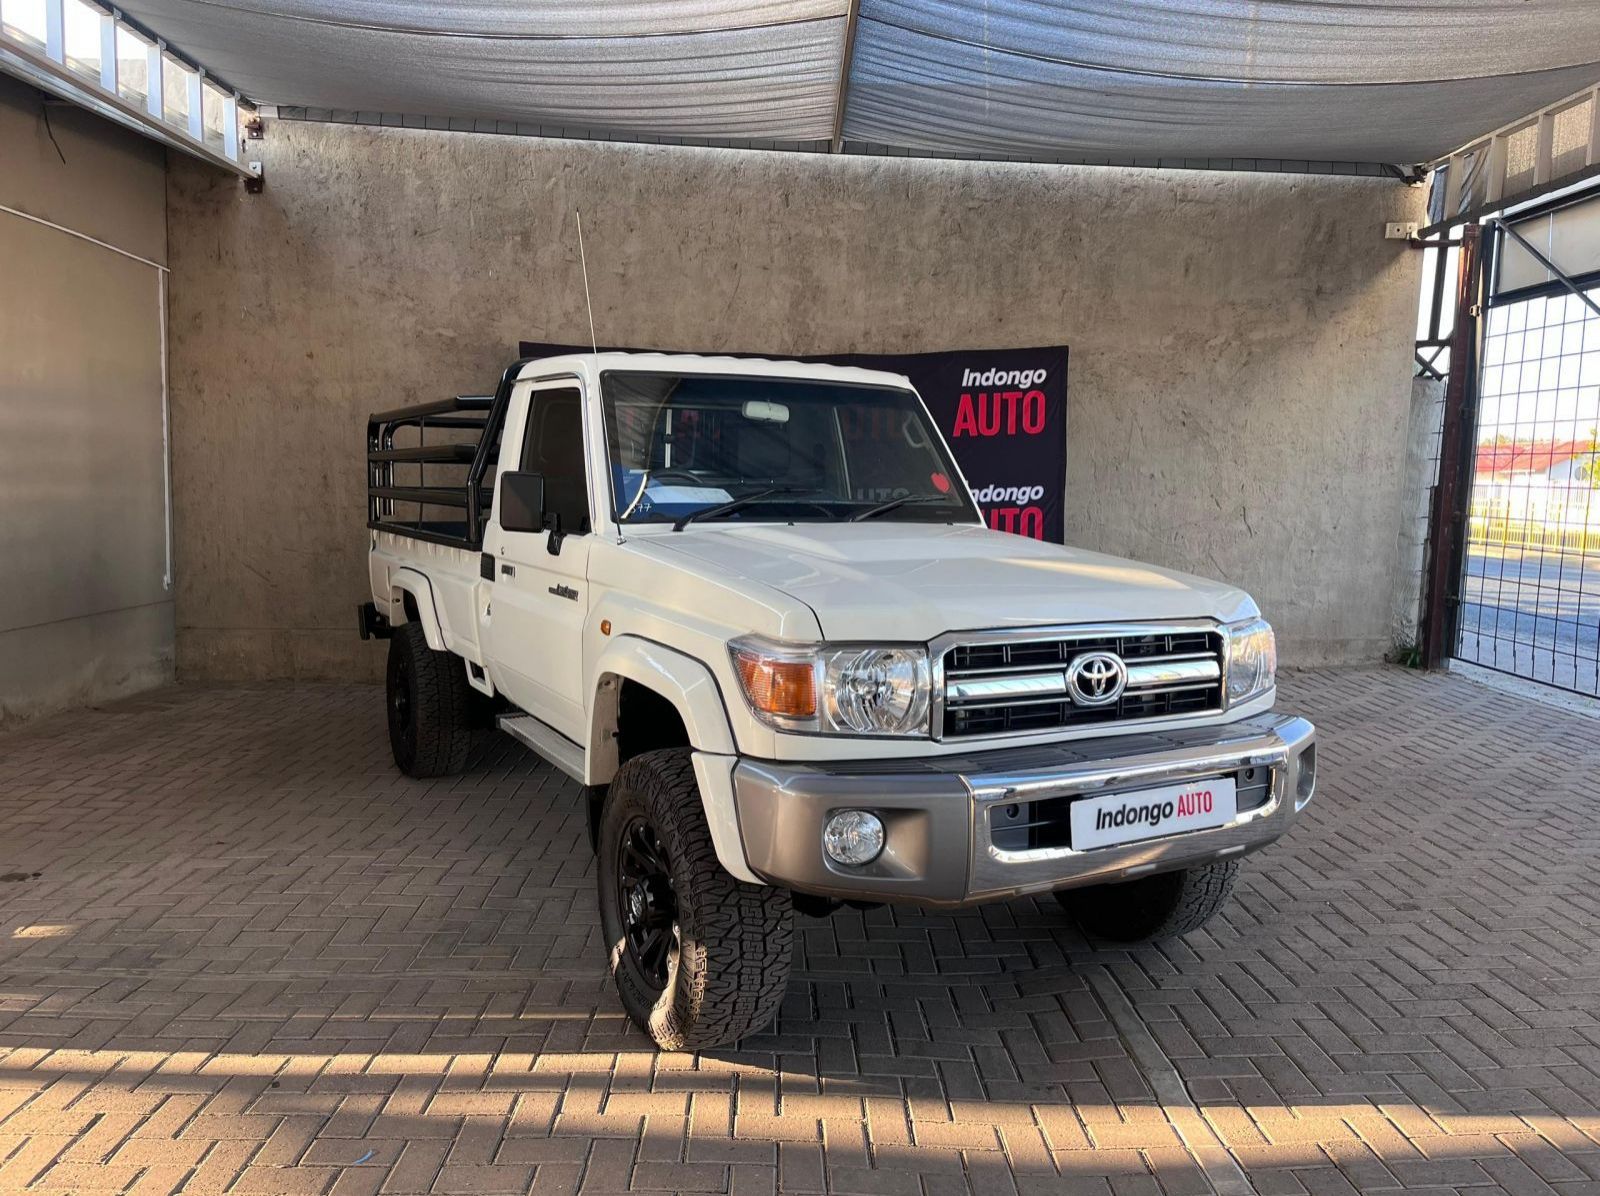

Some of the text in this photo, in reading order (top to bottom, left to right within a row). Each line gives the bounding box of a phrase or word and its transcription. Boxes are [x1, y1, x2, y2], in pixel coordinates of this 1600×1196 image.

[962, 367, 1047, 389] Indongo
[952, 390, 1046, 437] AUTO
[969, 483, 1044, 505] ndongo
[1096, 790, 1213, 830] Indongo AUTO
